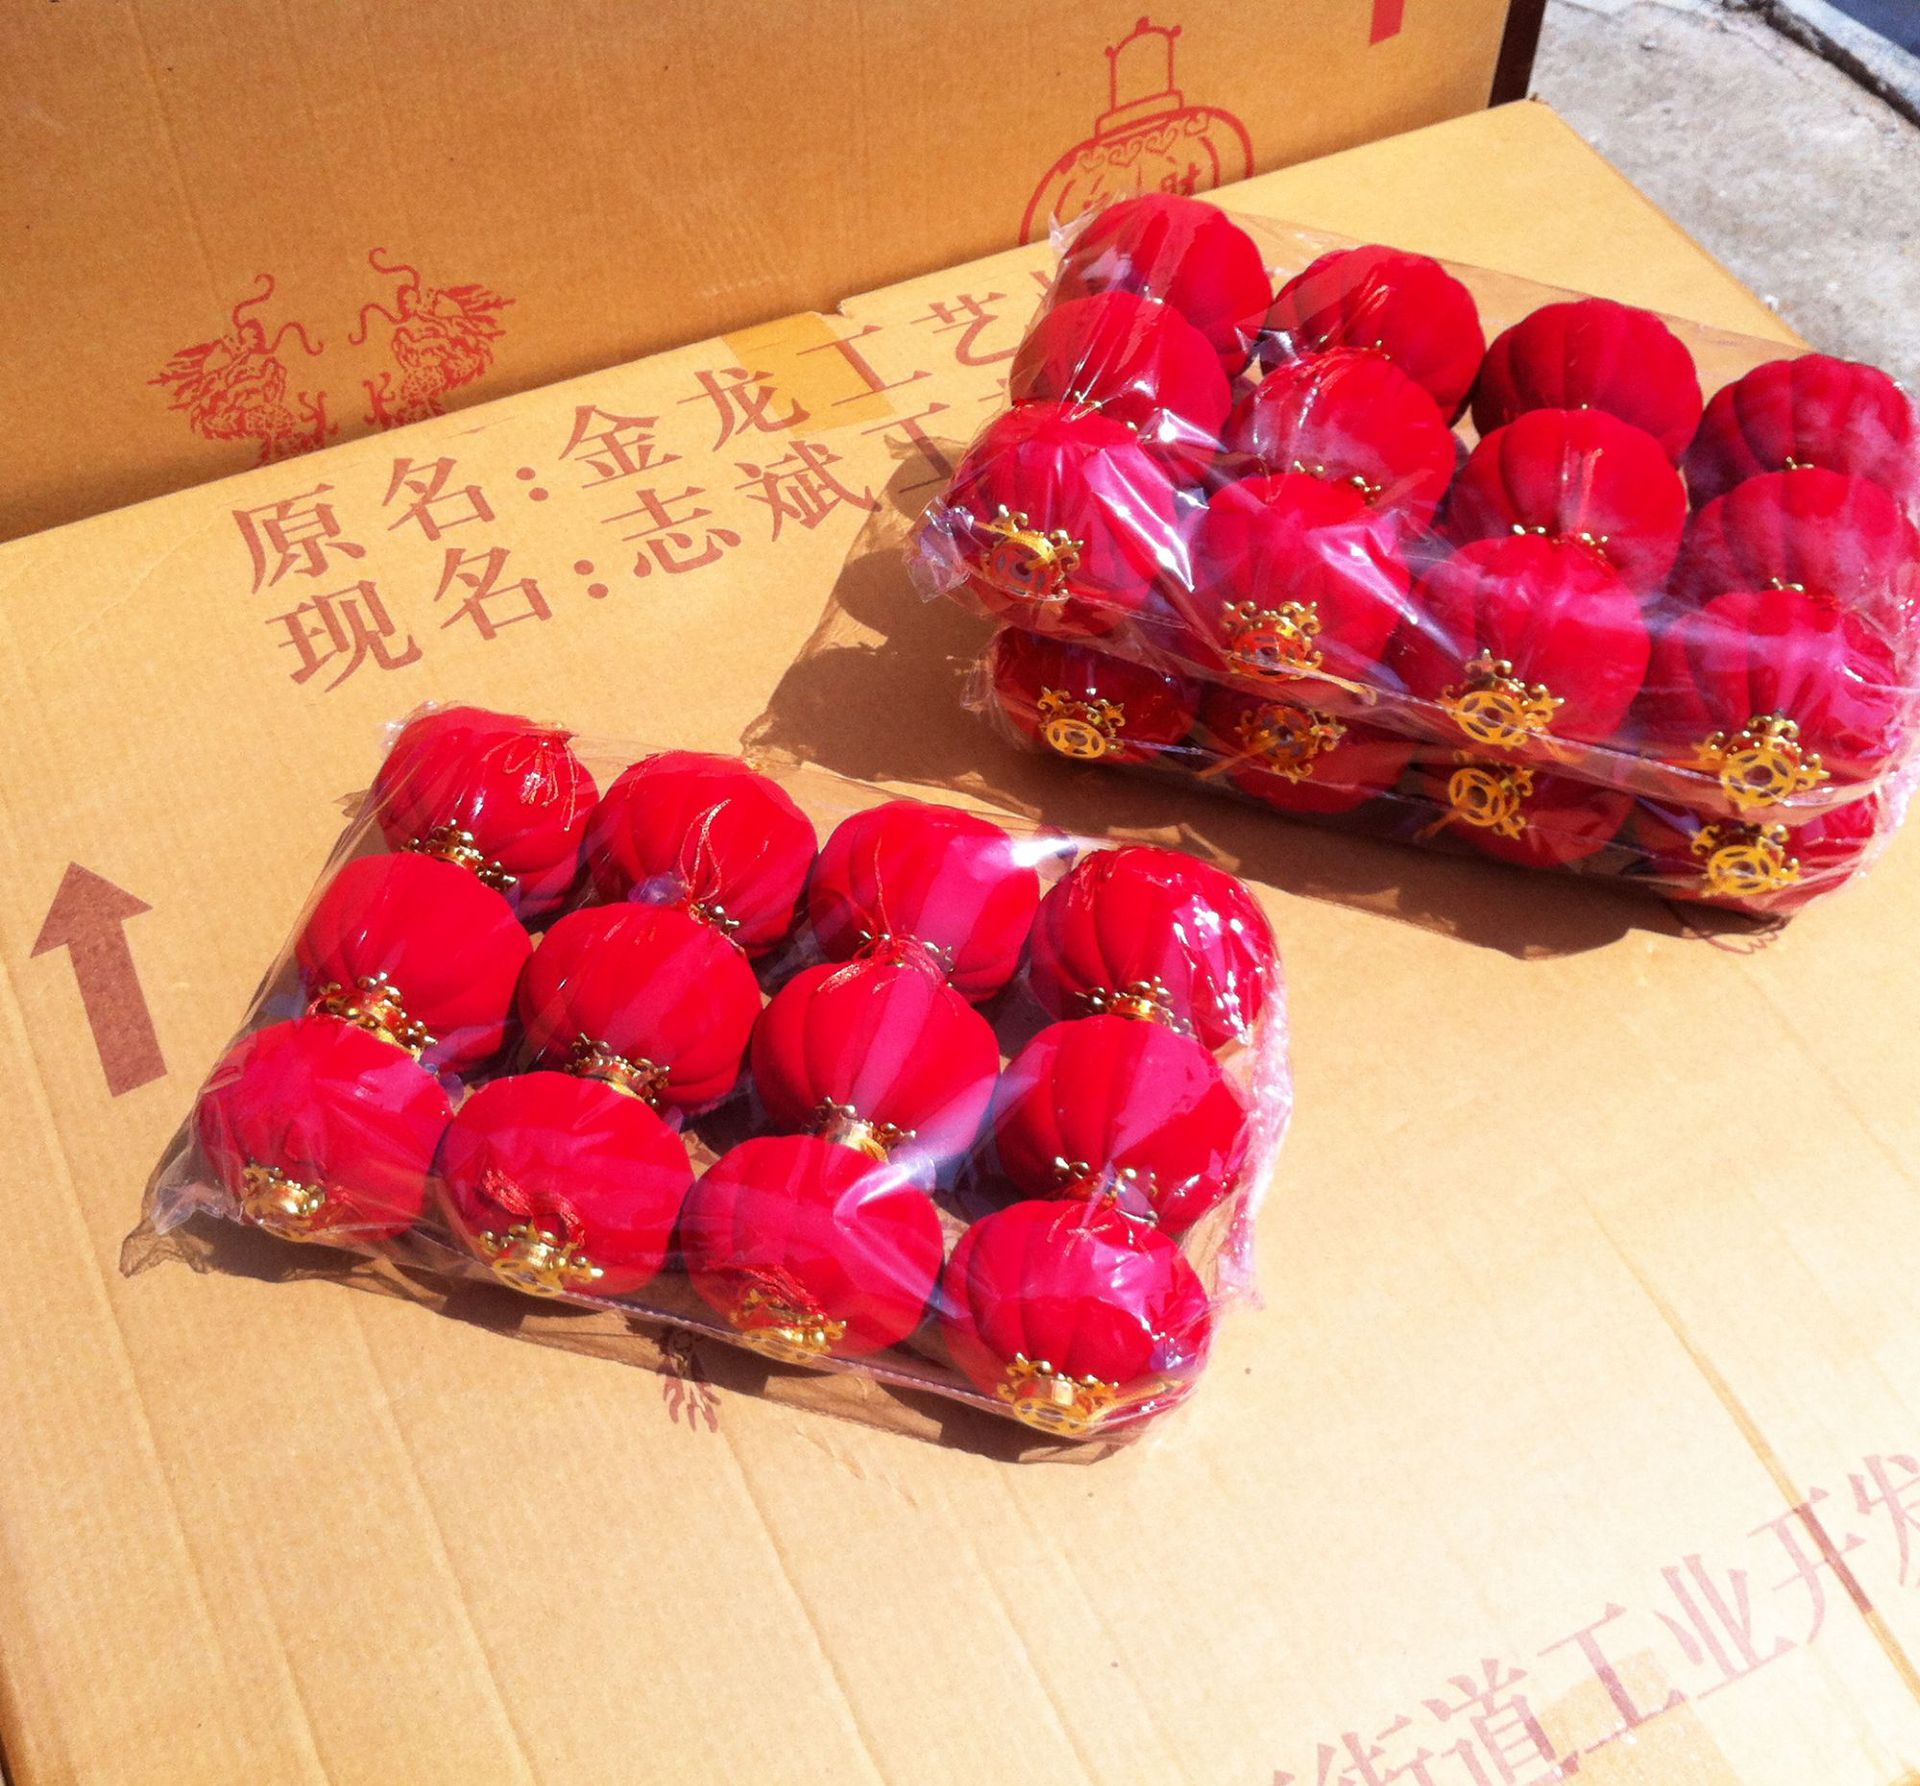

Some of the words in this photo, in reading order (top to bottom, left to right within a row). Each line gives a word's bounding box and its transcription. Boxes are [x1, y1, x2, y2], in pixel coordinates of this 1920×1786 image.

[231, 270, 1055, 594] 原名：金龙工艺
[266, 377, 1008, 693] 现名：志斌工
